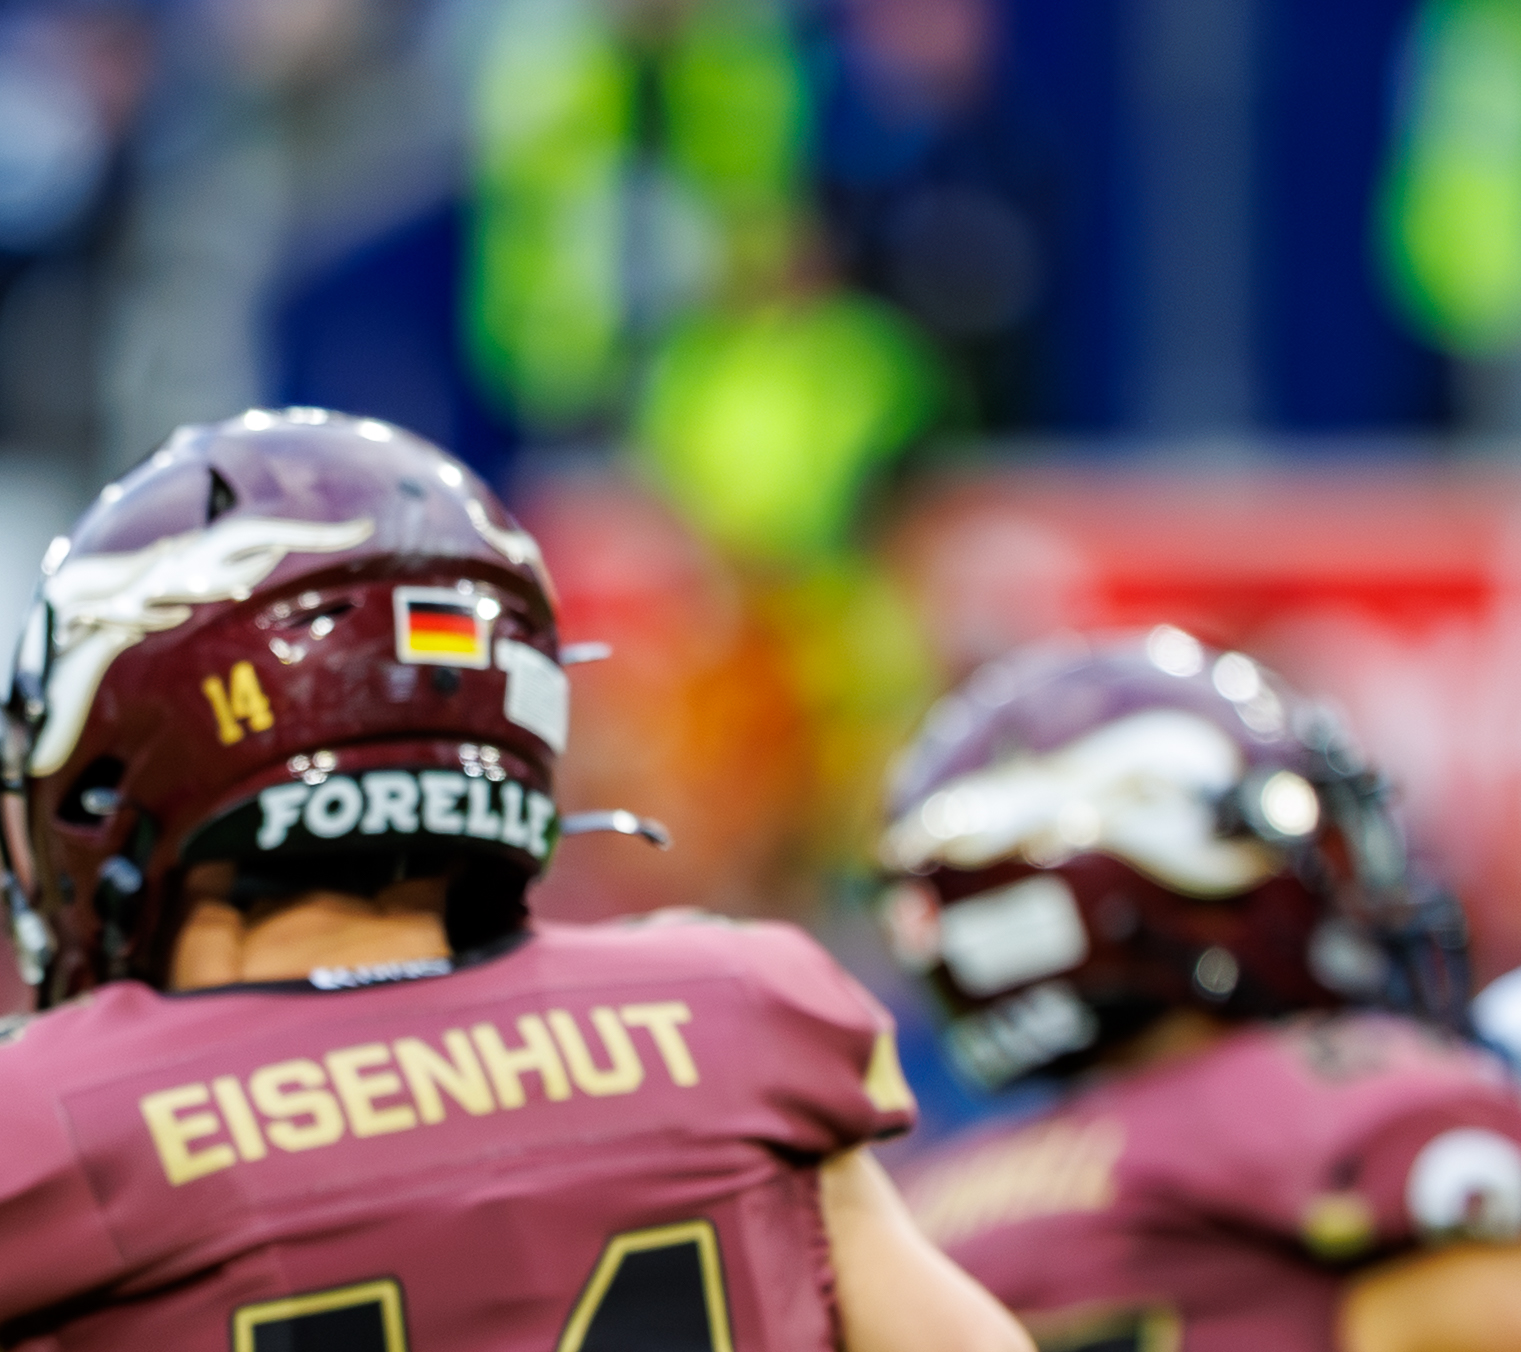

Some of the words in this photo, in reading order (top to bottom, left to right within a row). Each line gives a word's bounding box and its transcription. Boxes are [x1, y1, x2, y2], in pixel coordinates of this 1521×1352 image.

[201, 660, 276, 747] 14
[255, 769, 557, 859] FORELLE
[140, 1001, 702, 1187] EISENHUT
